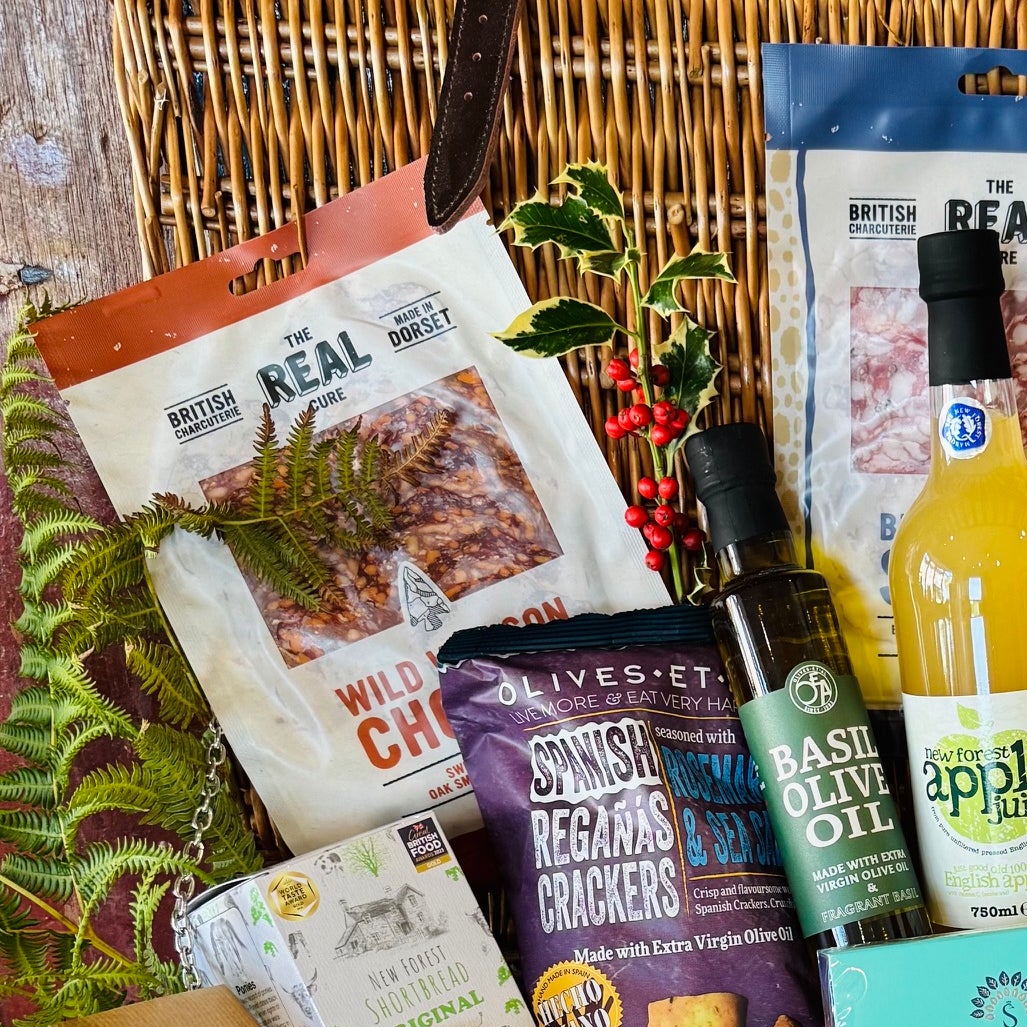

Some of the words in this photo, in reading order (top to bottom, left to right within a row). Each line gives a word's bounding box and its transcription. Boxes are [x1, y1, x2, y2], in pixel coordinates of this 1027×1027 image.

[849, 223, 916, 235] CHARCUTERIE
[850, 204, 916, 222] BRITISH
[388, 308, 452, 348] DORSET
[393, 307, 421, 326] MADE
[422, 301, 434, 312] IN
[284, 327, 313, 348] THE
[256, 331, 372, 408] REAL
[168, 389, 236, 428] BRITISH
[175, 406, 242, 440] CHARCUTERIE
[655, 726, 703, 743] seasoned
[705, 730, 736, 744] with
[925, 747, 953, 761] new
[957, 746, 1011, 761] forest
[532, 720, 657, 796] SPANISH
[769, 726, 879, 782] BASIL
[783, 763, 890, 818] OLIVE
[530, 790, 674, 869] REGAÑÁS
[806, 801, 895, 848] OIL
[812, 863, 845, 882] MADE
[846, 855, 877, 870] WITH
[879, 849, 906, 863] EXTRA
[816, 873, 859, 894] VIRGIN
[862, 866, 894, 882] OLIVE
[896, 862, 909, 872] OIL
[538, 857, 680, 933] CRACKERS
[971, 905, 1018, 918] 750ml
[574, 948, 614, 964] Made
[617, 942, 650, 958] with
[652, 939, 692, 955] Extra
[694, 933, 742, 952] Virgin
[744, 927, 778, 945] Olive
[779, 927, 793, 942] Oil
[365, 961, 469, 1025] SHORTBREAD
